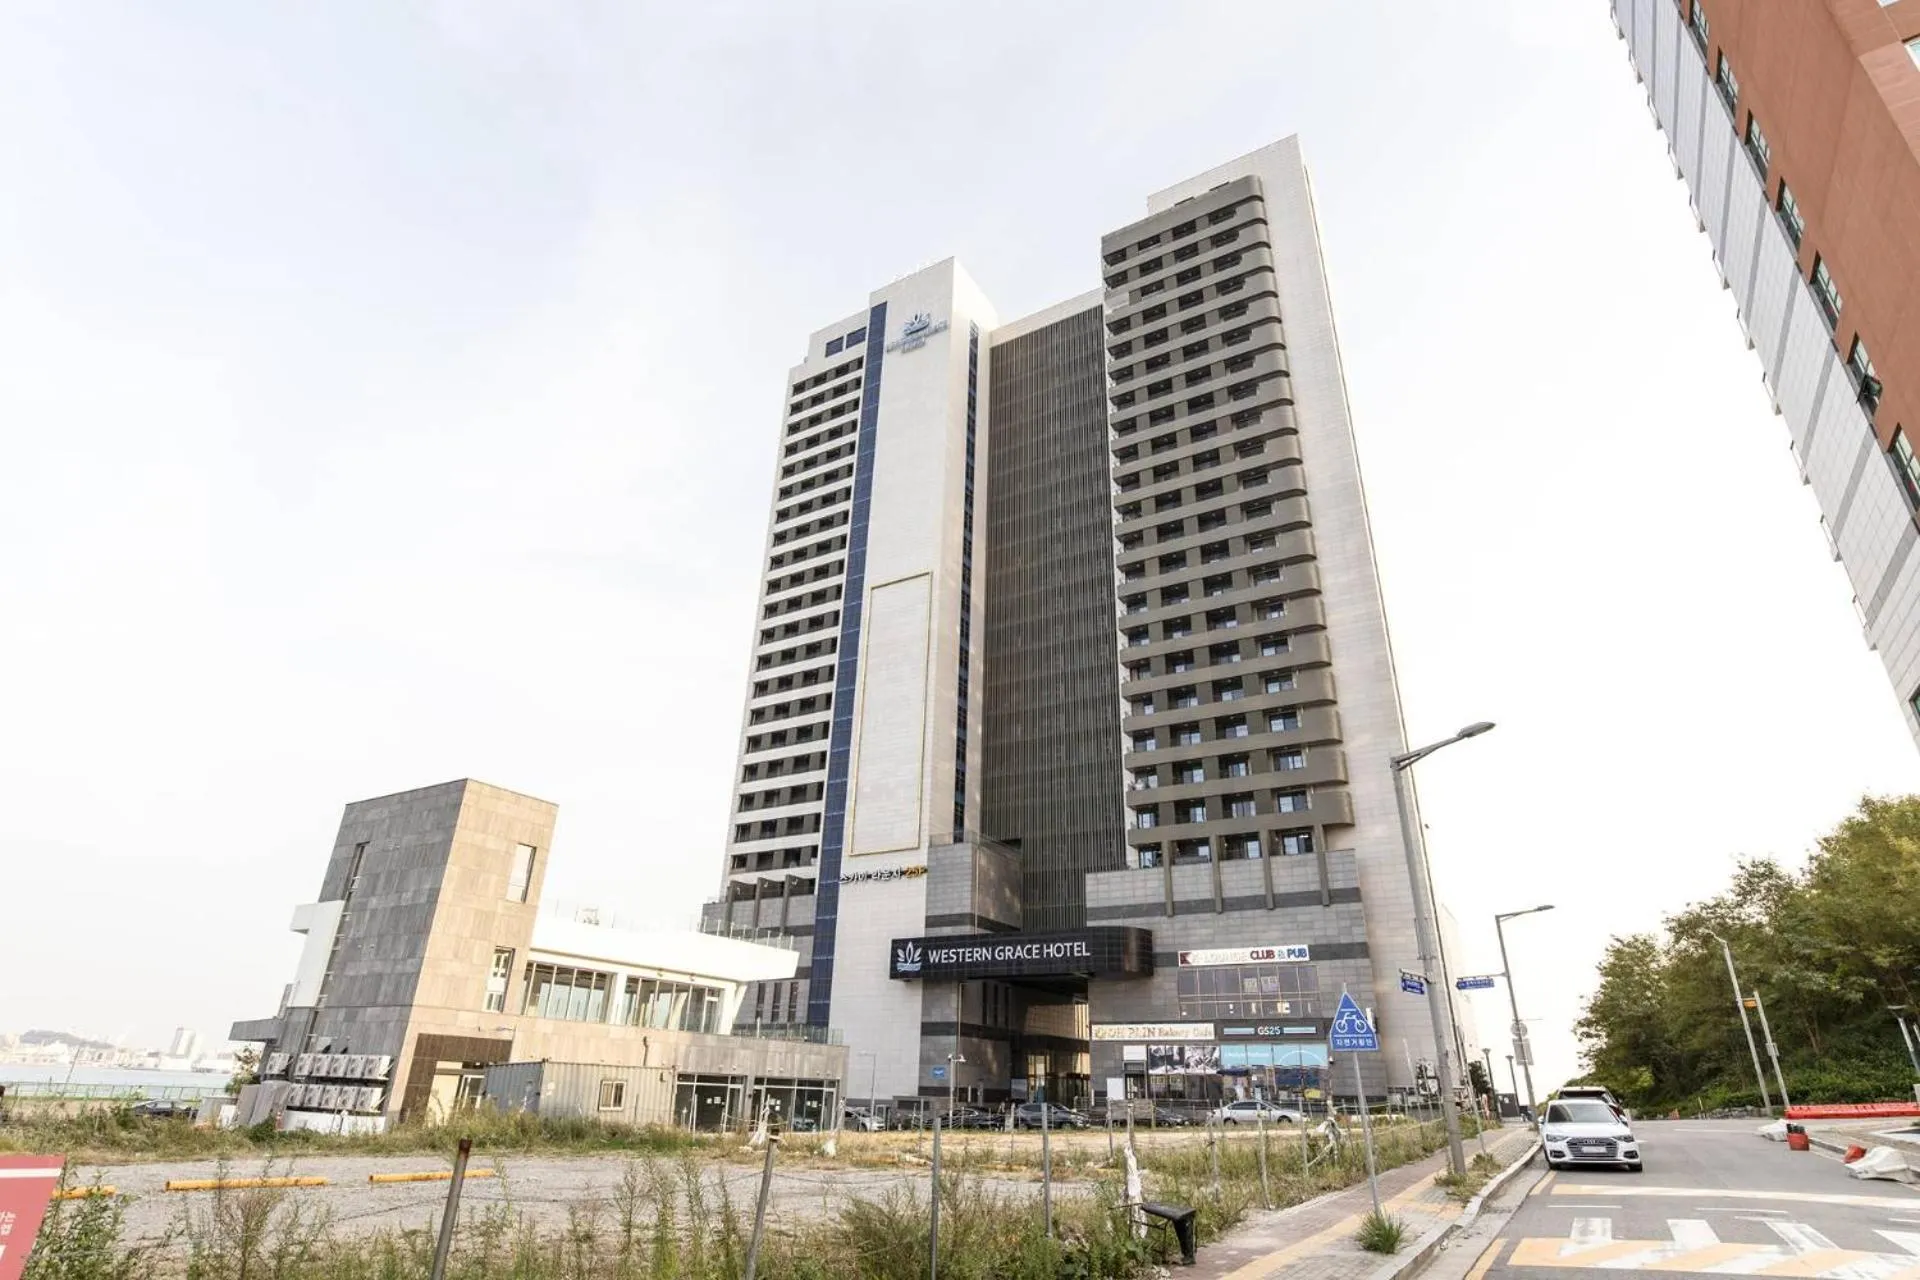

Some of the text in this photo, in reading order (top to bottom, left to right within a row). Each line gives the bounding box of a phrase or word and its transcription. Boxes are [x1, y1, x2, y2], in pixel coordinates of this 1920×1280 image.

[928, 941, 1091, 964] WESTERN GRACE HOTEL
[1249, 949, 1276, 961] CLUB
[1286, 947, 1308, 959] PUB
[1257, 1025, 1281, 1036] GS25
